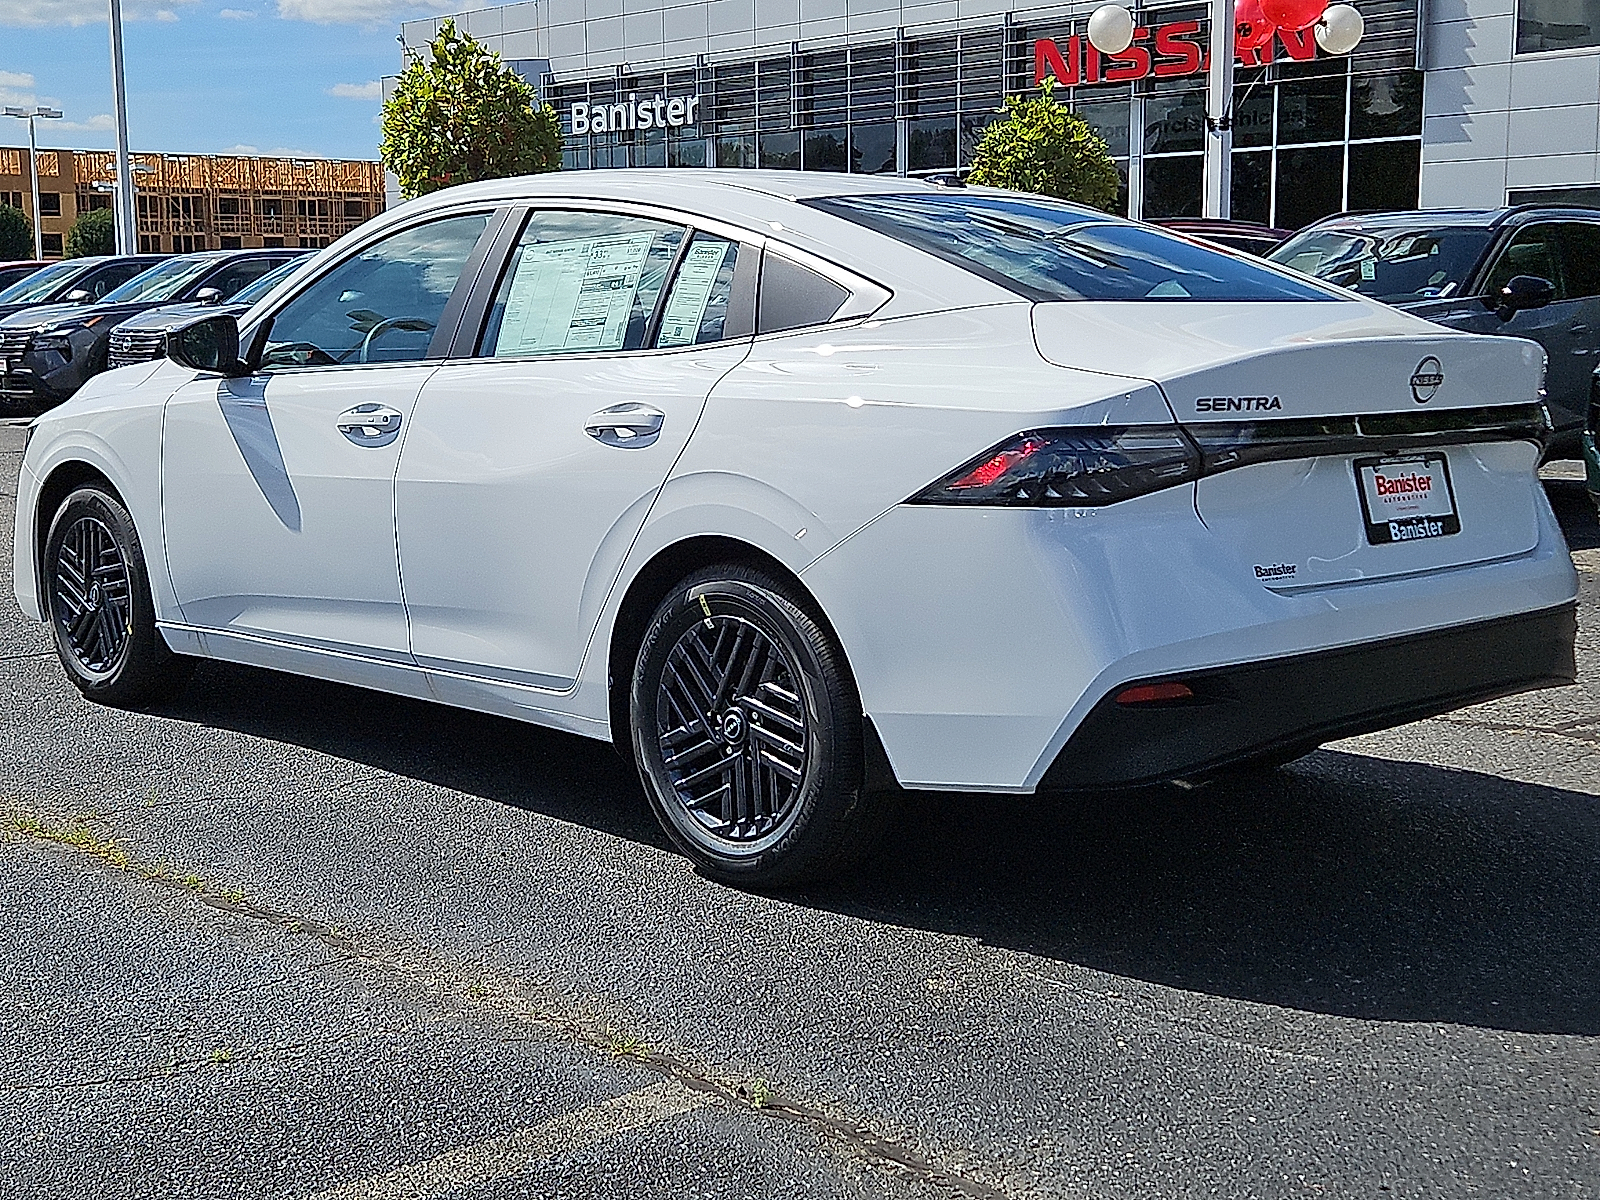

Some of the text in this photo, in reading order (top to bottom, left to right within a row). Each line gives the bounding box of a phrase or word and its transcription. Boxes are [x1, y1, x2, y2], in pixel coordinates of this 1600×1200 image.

[1034, 21, 1316, 86] NISSN
[571, 93, 699, 134] Banister
[1196, 397, 1282, 412] SENTRA
[1374, 472, 1431, 496] Banister
[1388, 519, 1444, 541] Banister
[1253, 563, 1297, 578] Banister
